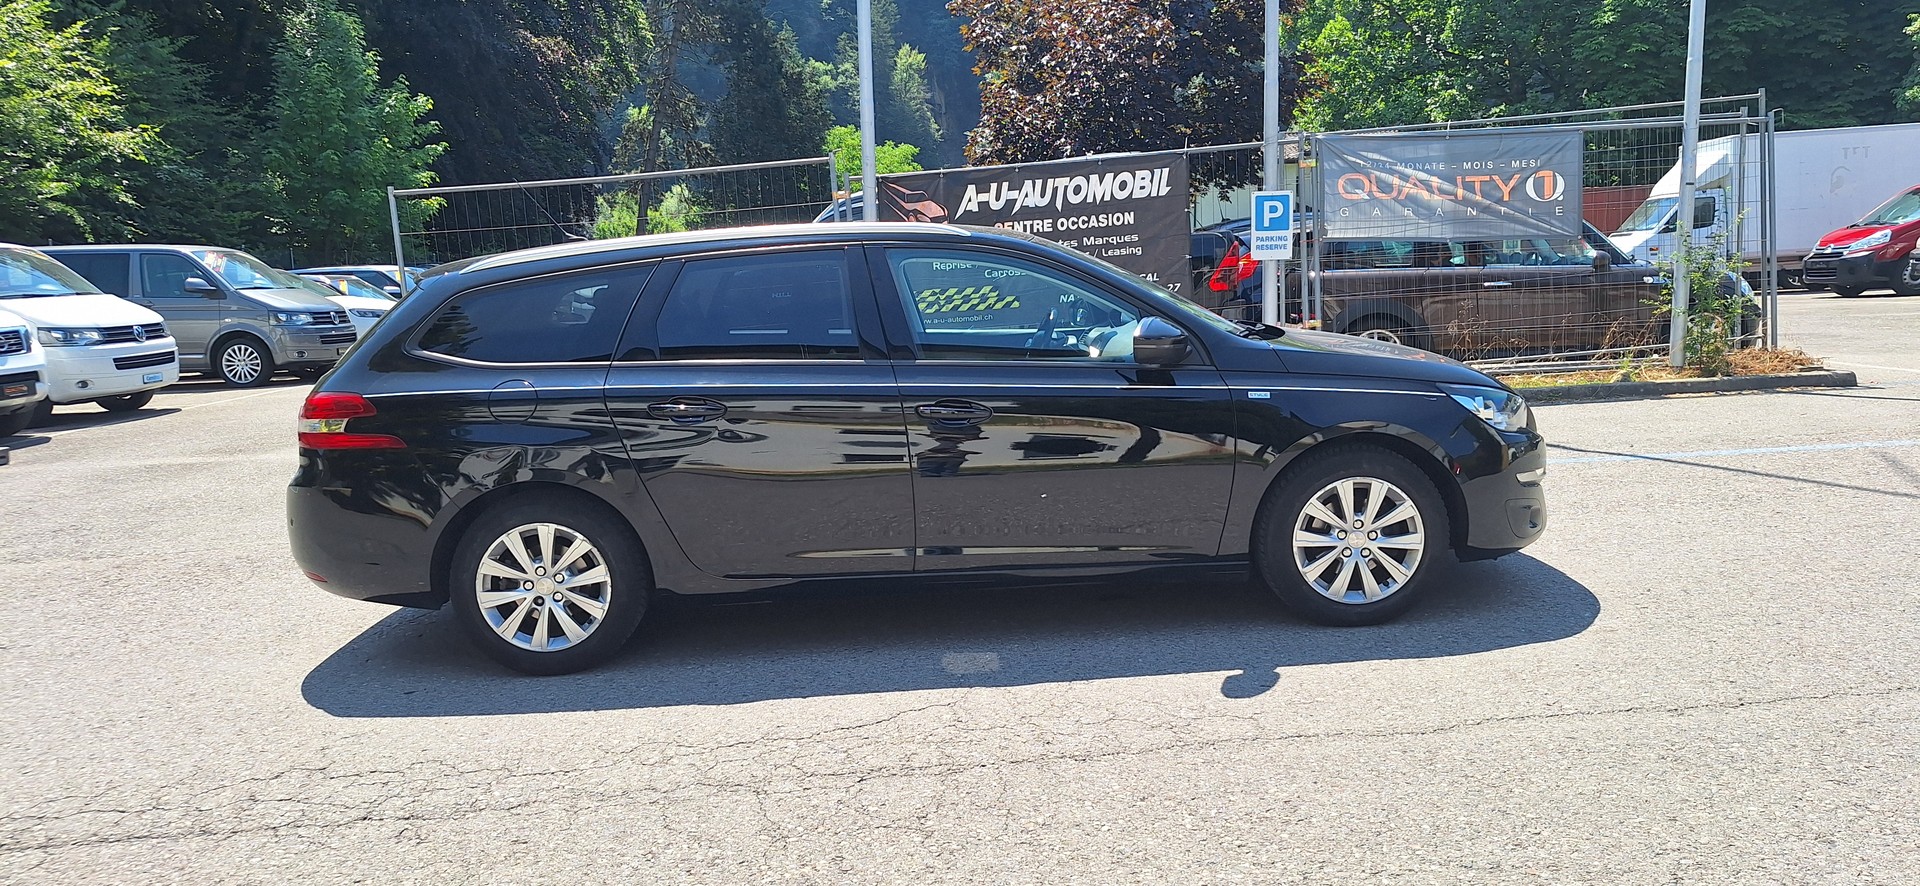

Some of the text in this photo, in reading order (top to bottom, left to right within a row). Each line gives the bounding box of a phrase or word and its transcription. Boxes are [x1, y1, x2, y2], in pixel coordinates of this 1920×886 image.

[1396, 162, 1446, 170] MONATE
[1463, 161, 1494, 170] MOIS
[1511, 159, 1541, 168] MESI
[1337, 172, 1521, 202] QUALITY
[955, 167, 1172, 221] A-U-AUTOMOBIL
[1263, 200, 1284, 227] P
[1340, 205, 1564, 218] GARANTIE
[1057, 211, 1135, 231] OCCASION
[1082, 233, 1139, 246] Marques
[1255, 235, 1289, 243] PARKING
[1102, 246, 1142, 256] Leasing
[1255, 243, 1288, 251] RESERVE
[932, 261, 973, 272] Reprise
[985, 268, 1027, 278] Carros
[1167, 281, 1181, 292] 27
